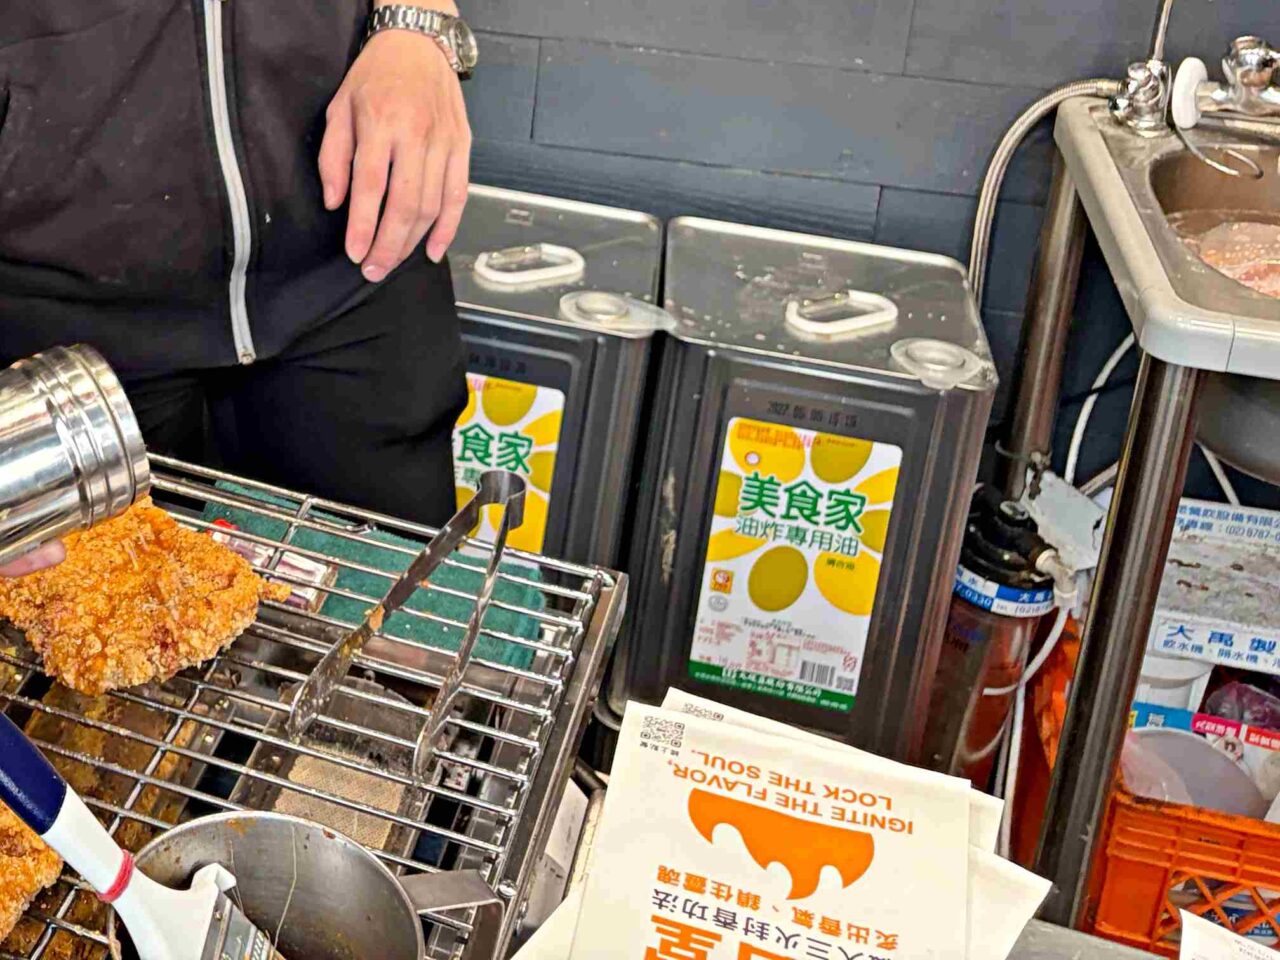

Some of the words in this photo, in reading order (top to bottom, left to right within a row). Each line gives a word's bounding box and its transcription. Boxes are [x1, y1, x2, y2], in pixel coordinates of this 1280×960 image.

[454, 423, 533, 474] 食家
[740, 471, 867, 533] 美食家
[735, 515, 859, 558] 油炸專用油
[691, 749, 762, 779] SOUL.
[667, 759, 768, 802] FLAVOR,
[768, 770, 816, 796] THE
[774, 792, 823, 817] THE
[822, 784, 893, 811] LOCK
[830, 805, 914, 835] IGNITE
